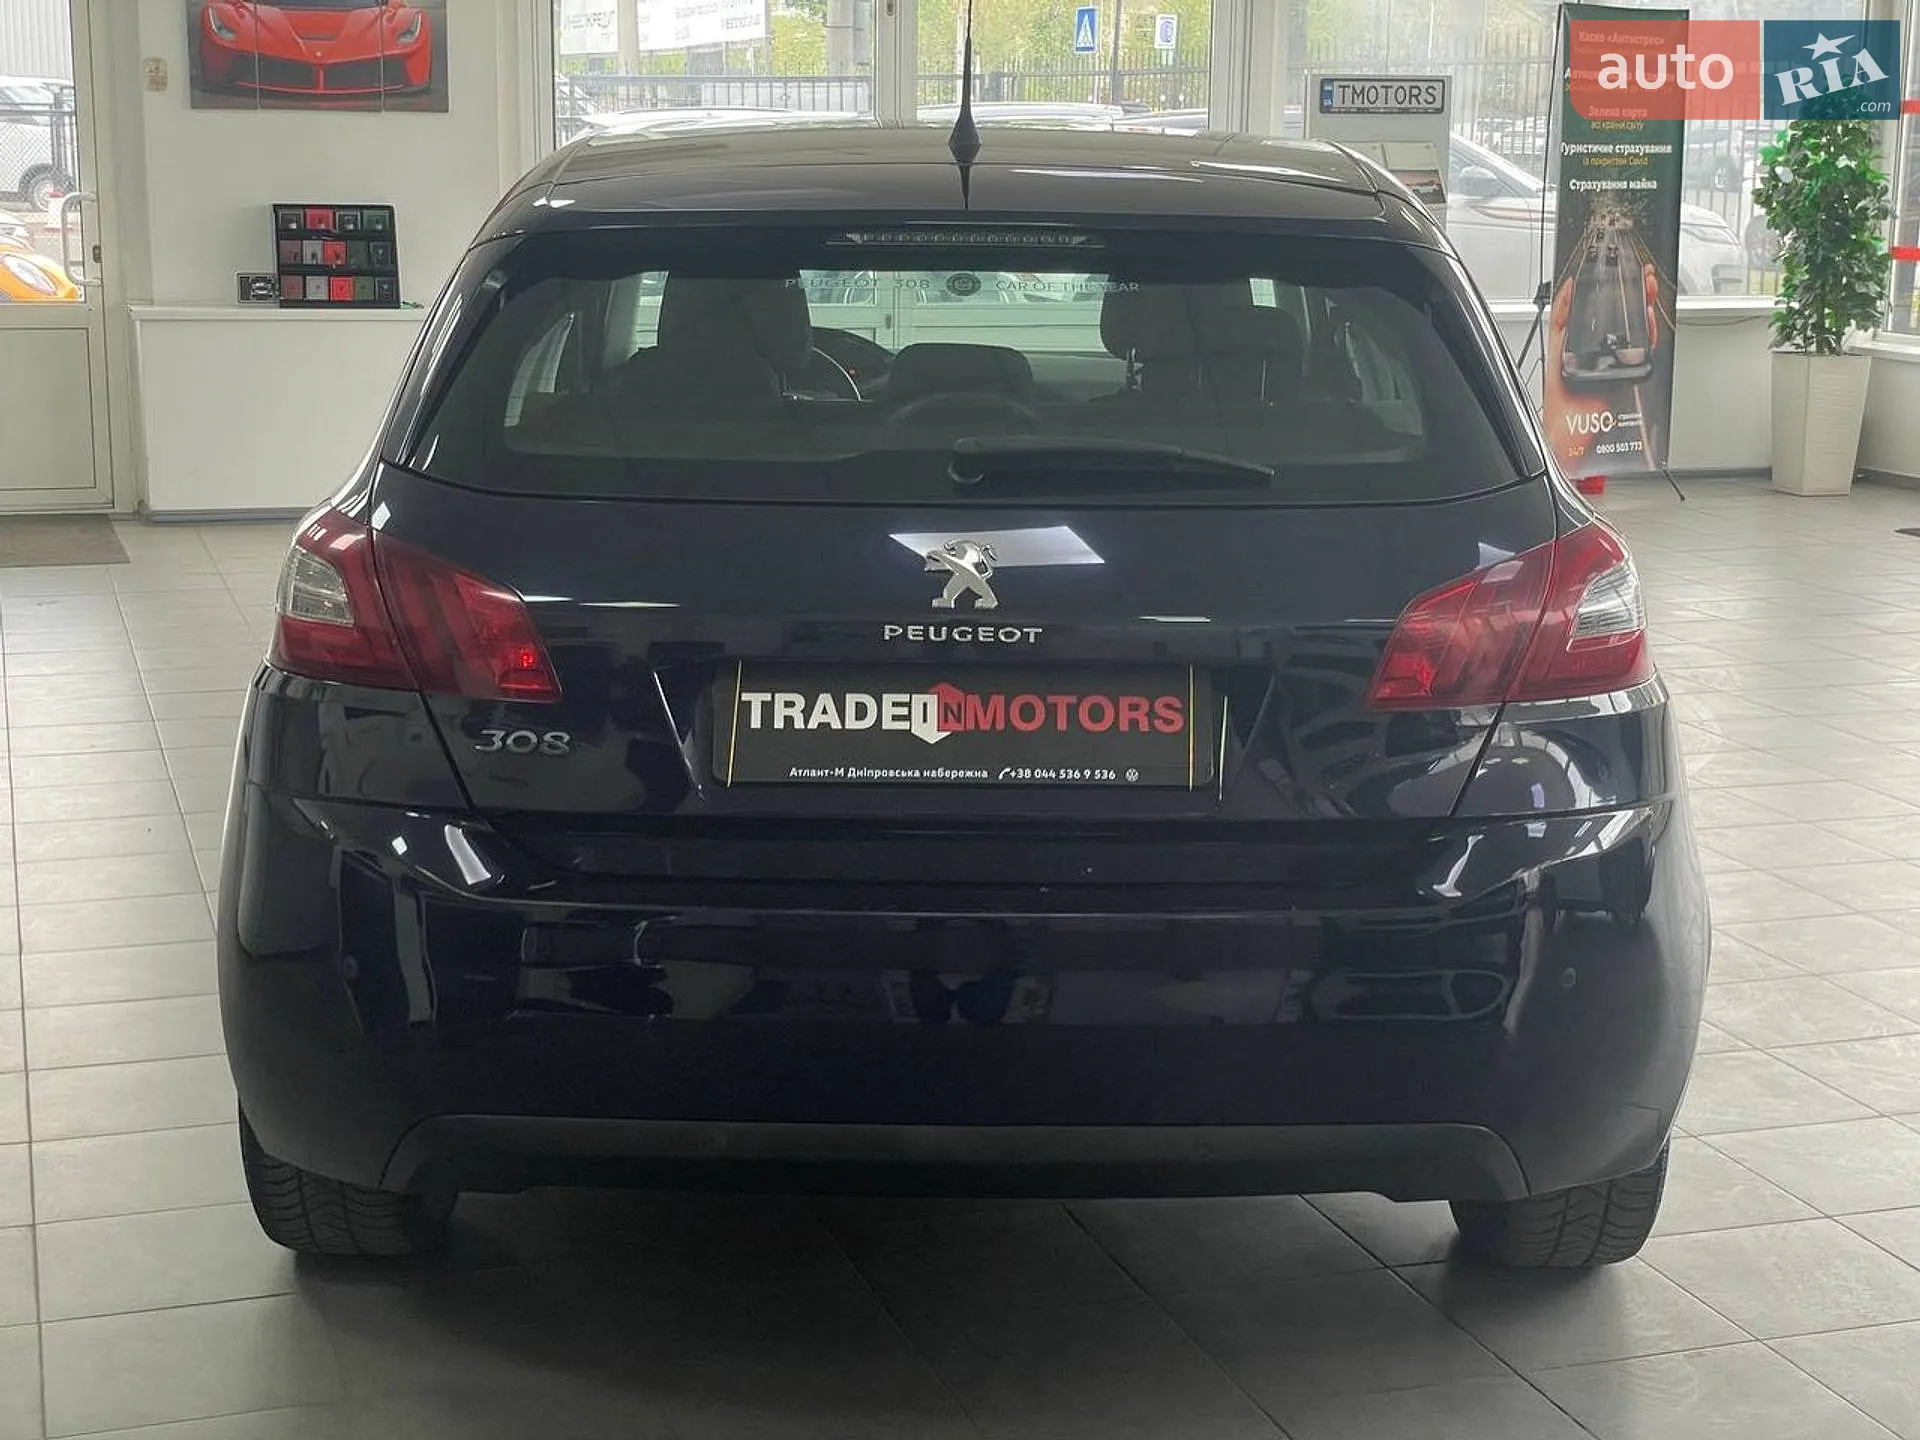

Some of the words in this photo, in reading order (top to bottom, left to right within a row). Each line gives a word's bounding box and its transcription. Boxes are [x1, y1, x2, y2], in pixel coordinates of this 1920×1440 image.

[1338, 85, 1437, 105] TMOTORS
[995, 280, 1028, 291] CAR
[1565, 411, 1613, 435] VUSO
[884, 625, 1042, 643] PEUGEOT
[474, 730, 570, 755] 308
[789, 767, 845, 778] Атлант-М
[848, 767, 920, 780] Дніпровська
[1010, 768, 1032, 779] +38
[1034, 769, 1056, 779] 044
[1059, 769, 1081, 780] 536
[1083, 770, 1091, 780] 9
[1094, 770, 1116, 780] 536
